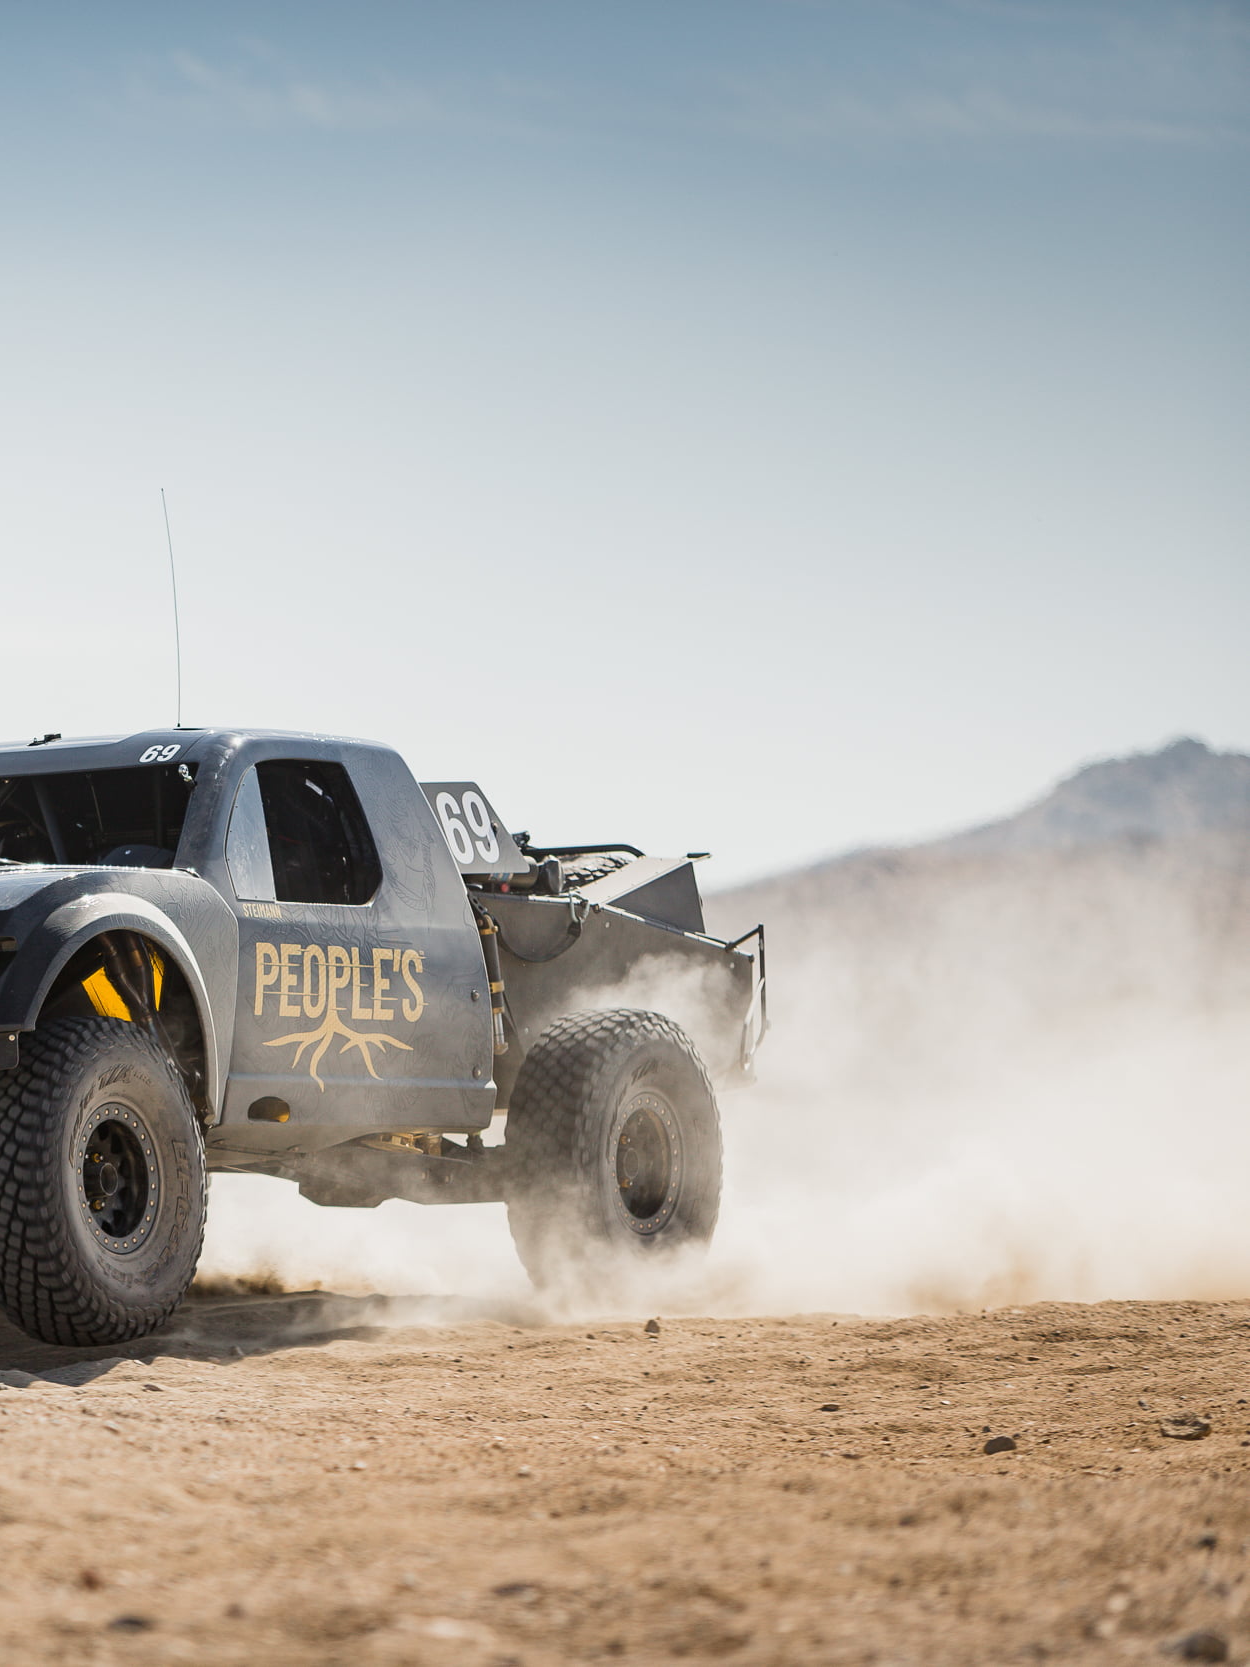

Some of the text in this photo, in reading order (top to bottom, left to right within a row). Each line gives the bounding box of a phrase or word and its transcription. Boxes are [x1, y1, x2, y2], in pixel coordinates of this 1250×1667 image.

[139, 744, 181, 763] 69
[436, 790, 500, 865] 69
[254, 942, 427, 1023] PEOPLE'S
